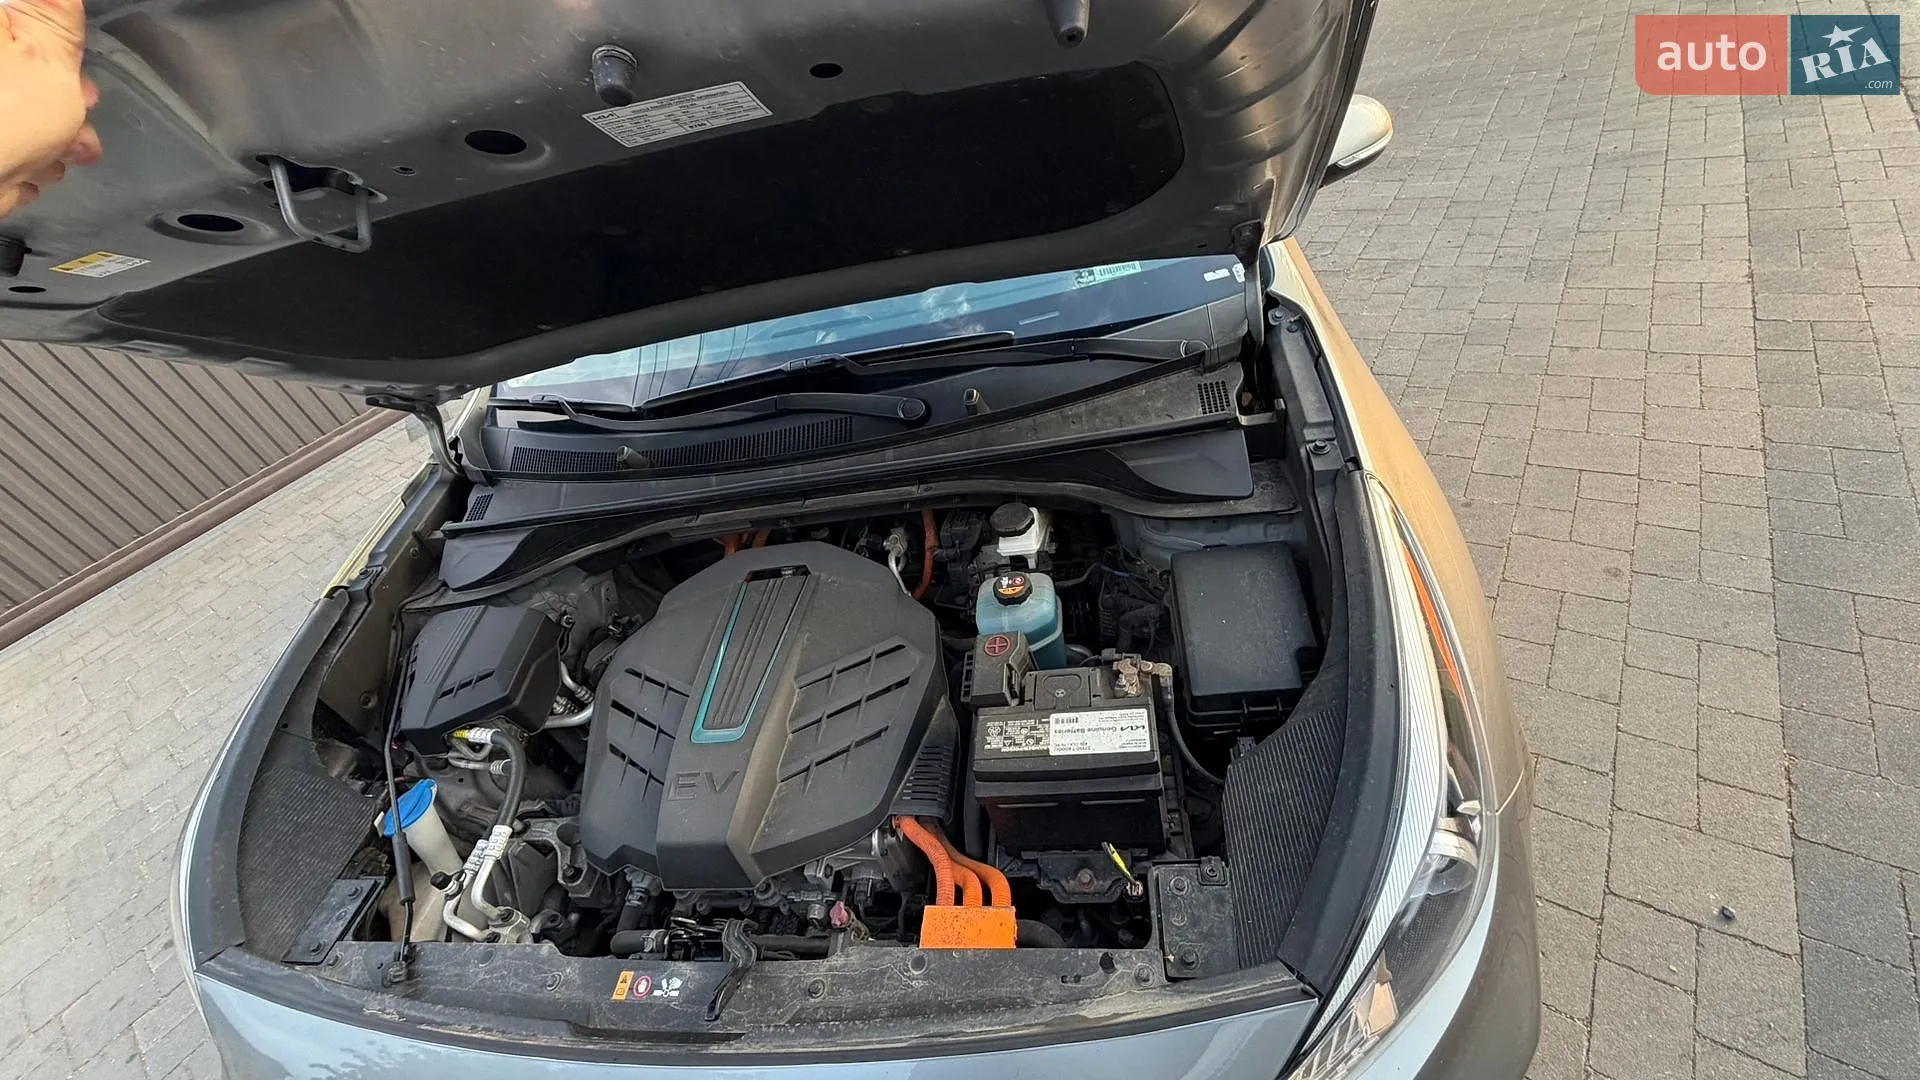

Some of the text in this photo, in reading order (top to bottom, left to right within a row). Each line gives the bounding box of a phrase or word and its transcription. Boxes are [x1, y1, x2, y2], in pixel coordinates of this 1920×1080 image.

[1054, 724, 1145, 735] KIA Genuine Batteries
[667, 769, 740, 801] EV
